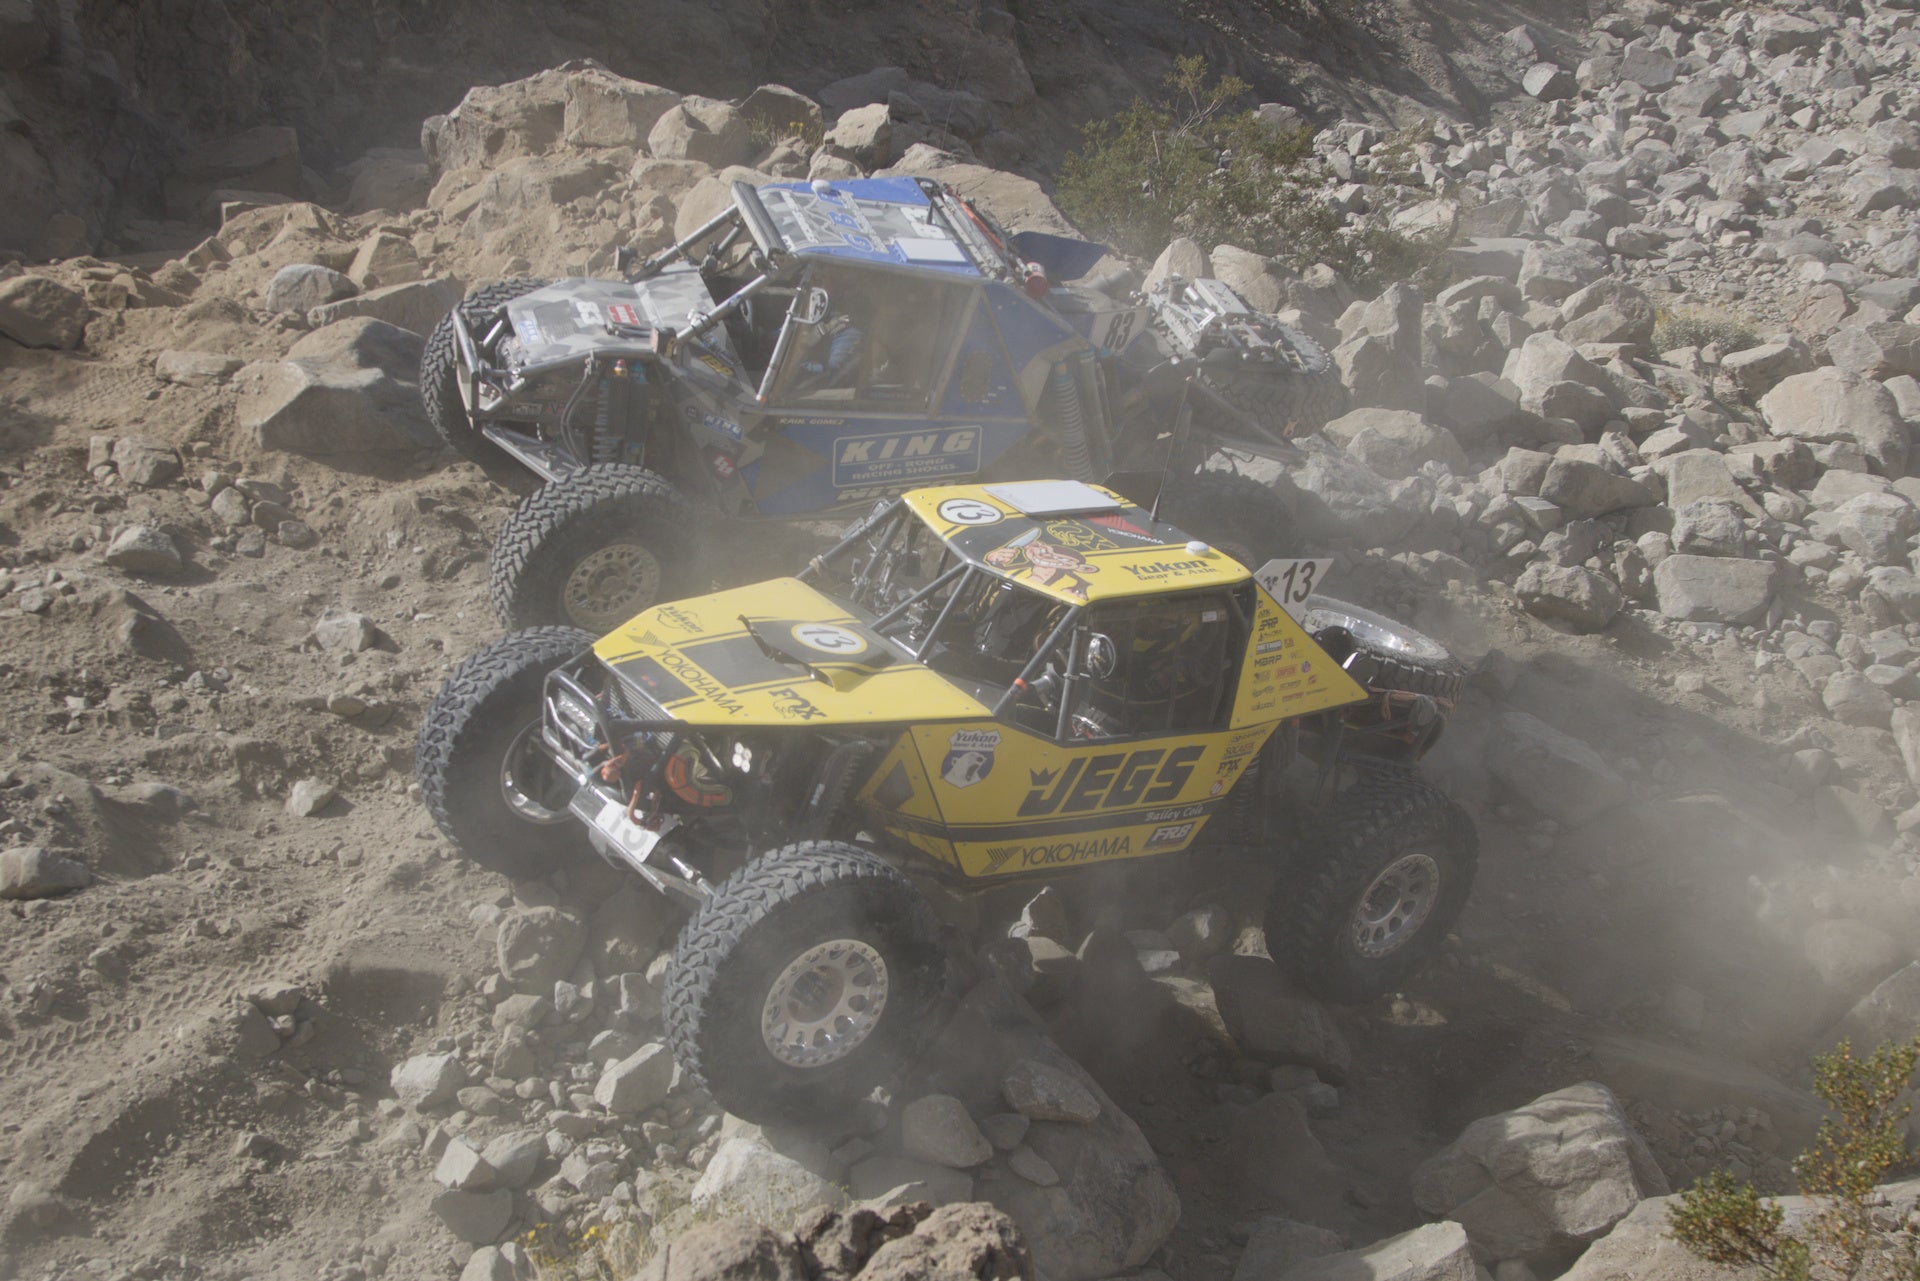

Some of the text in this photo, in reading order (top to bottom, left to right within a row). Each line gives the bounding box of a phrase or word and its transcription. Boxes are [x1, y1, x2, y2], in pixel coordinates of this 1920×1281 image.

[1104, 311, 1136, 350] 83
[704, 415, 743, 435] KING
[840, 431, 976, 464] KING
[852, 468, 903, 480] RACING
[868, 462, 893, 472] OFF
[905, 458, 946, 468] ROAD
[947, 502, 996, 521] 13
[1107, 527, 1165, 545] YOKOHAMA
[1120, 560, 1208, 576] Yukon
[1137, 571, 1170, 582] Gear
[1188, 566, 1217, 577] Axle
[1282, 561, 1317, 604] 13
[657, 605, 705, 633] Yukon
[803, 627, 857, 649] 13
[1254, 654, 1282, 668] MBRP
[656, 649, 745, 715] YOKOHAMA
[768, 687, 828, 720] FOX
[956, 732, 998, 744] Yukon
[1017, 745, 1208, 818] JEGS
[1145, 809, 1181, 822] Bailey
[1023, 835, 1132, 867] YOKOHAMA
